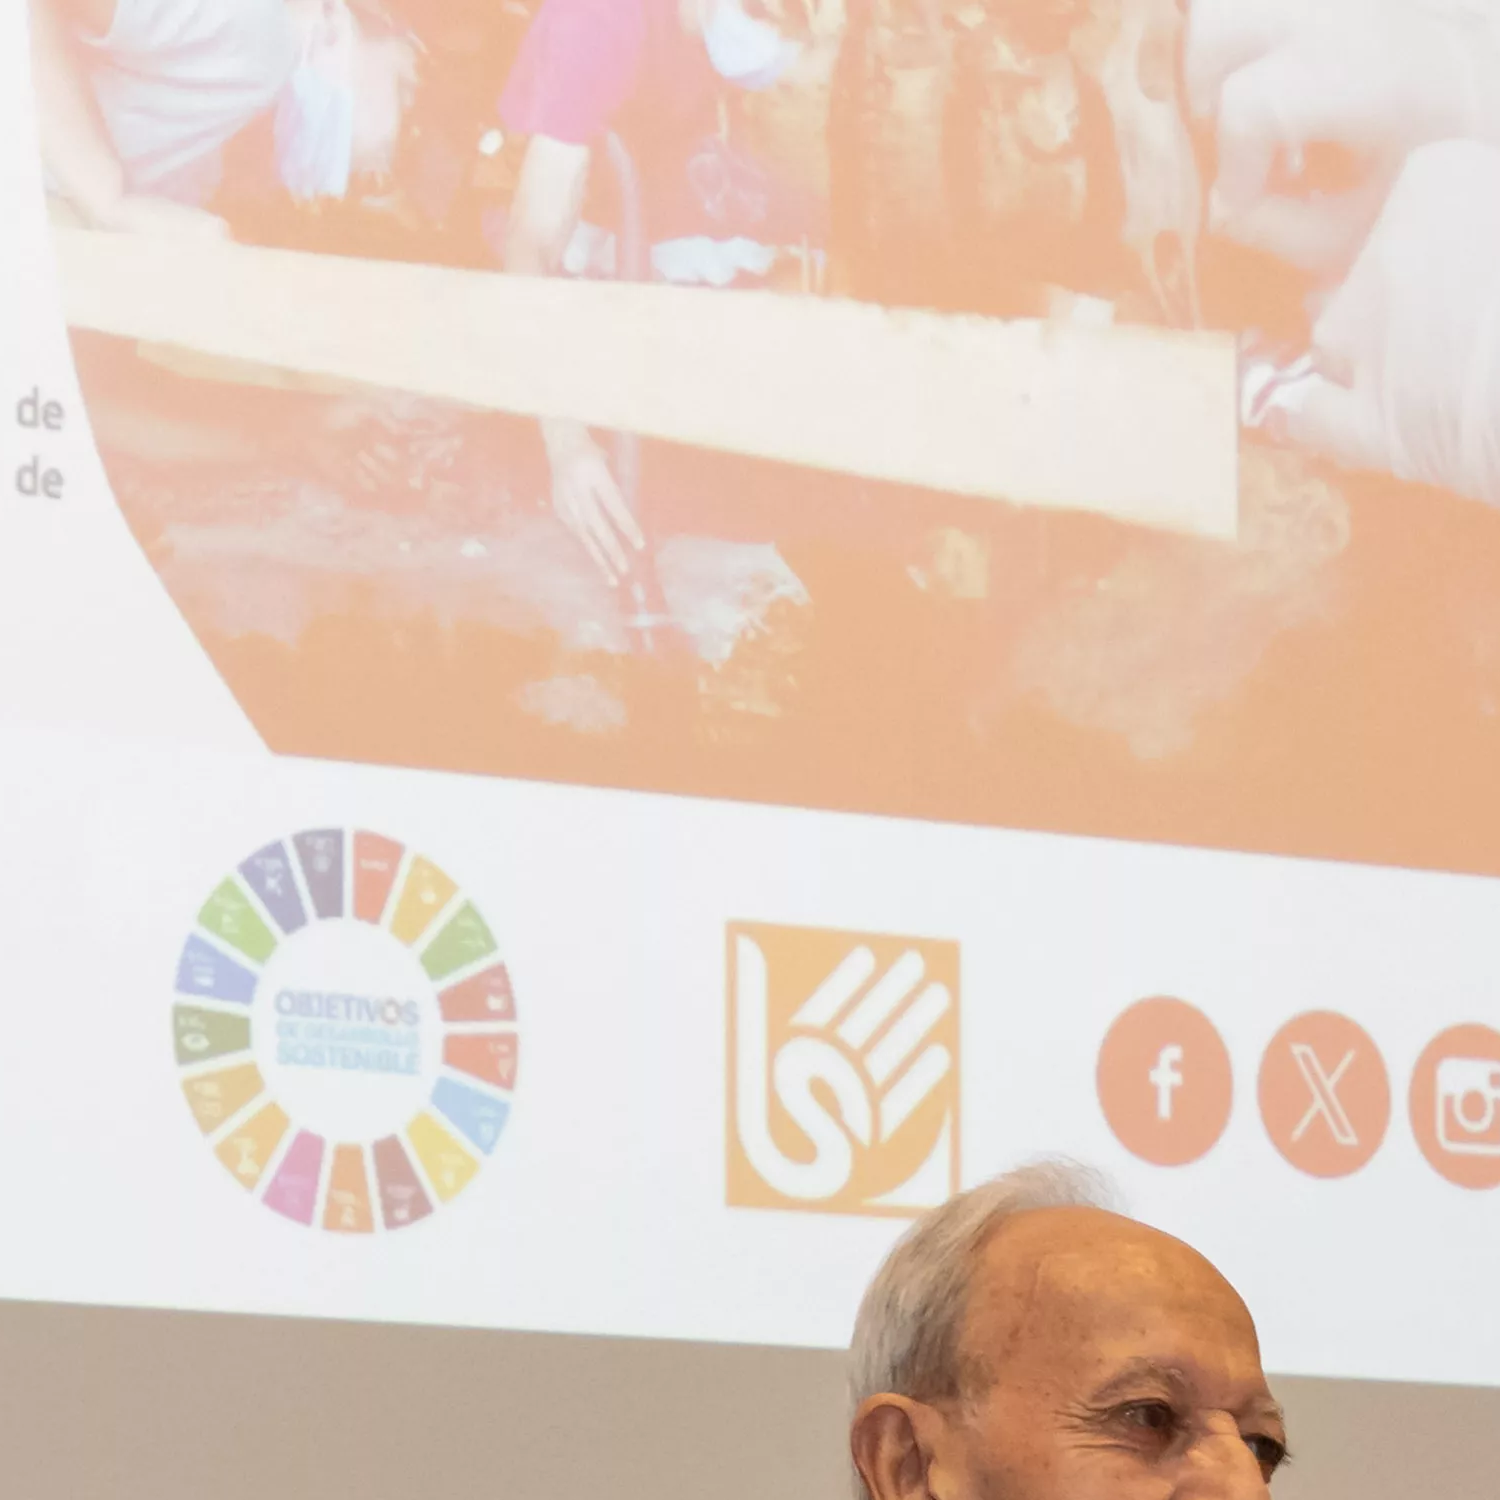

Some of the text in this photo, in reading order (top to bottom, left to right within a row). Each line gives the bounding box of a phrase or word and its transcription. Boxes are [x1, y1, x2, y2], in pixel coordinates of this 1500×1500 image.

[15, 385, 66, 432] de
[14, 454, 65, 501] de
[274, 990, 420, 1026] OBJETIVOS
